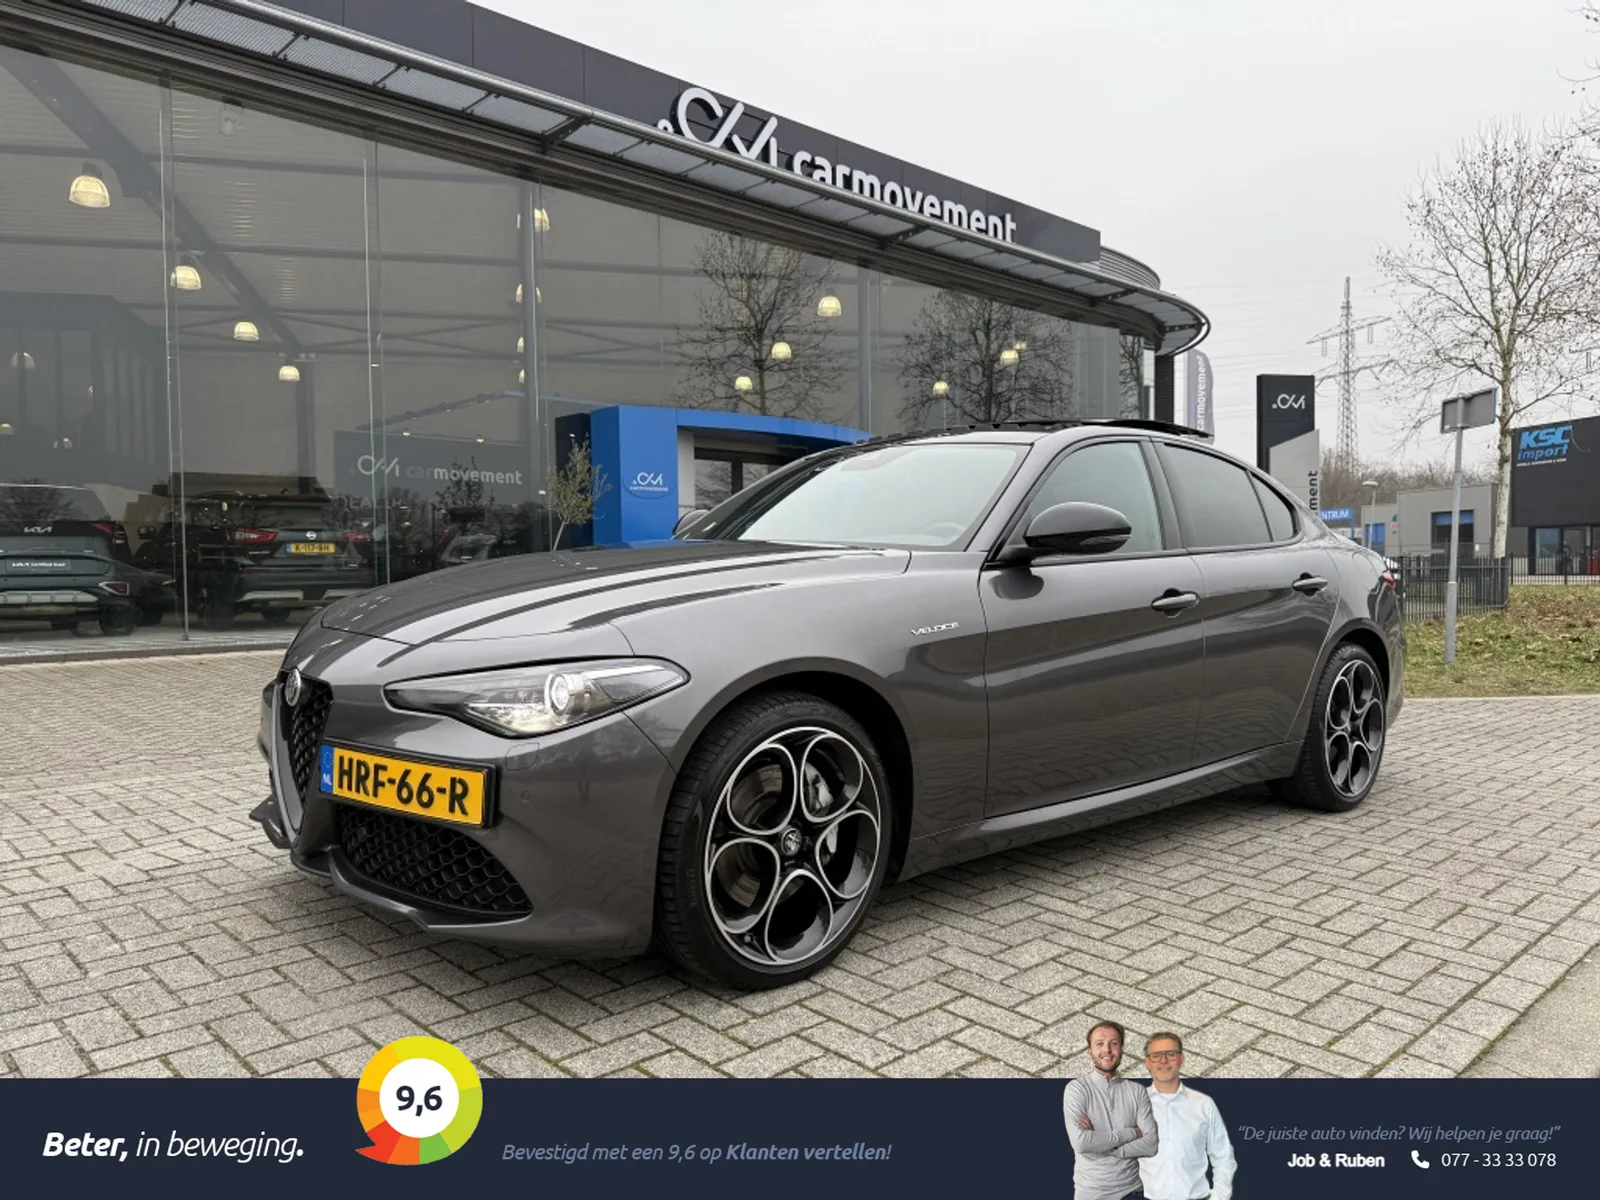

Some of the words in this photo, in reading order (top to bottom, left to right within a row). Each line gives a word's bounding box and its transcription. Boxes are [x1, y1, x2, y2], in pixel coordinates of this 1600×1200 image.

[793, 150, 1017, 244] carmovement
[1520, 425, 1573, 450] KSC
[1517, 443, 1569, 461] import
[406, 466, 523, 485] carmovement
[1320, 509, 1349, 520] NTRUM
[911, 621, 960, 635] VELOCE
[337, 755, 469, 816] HRF-66-R
